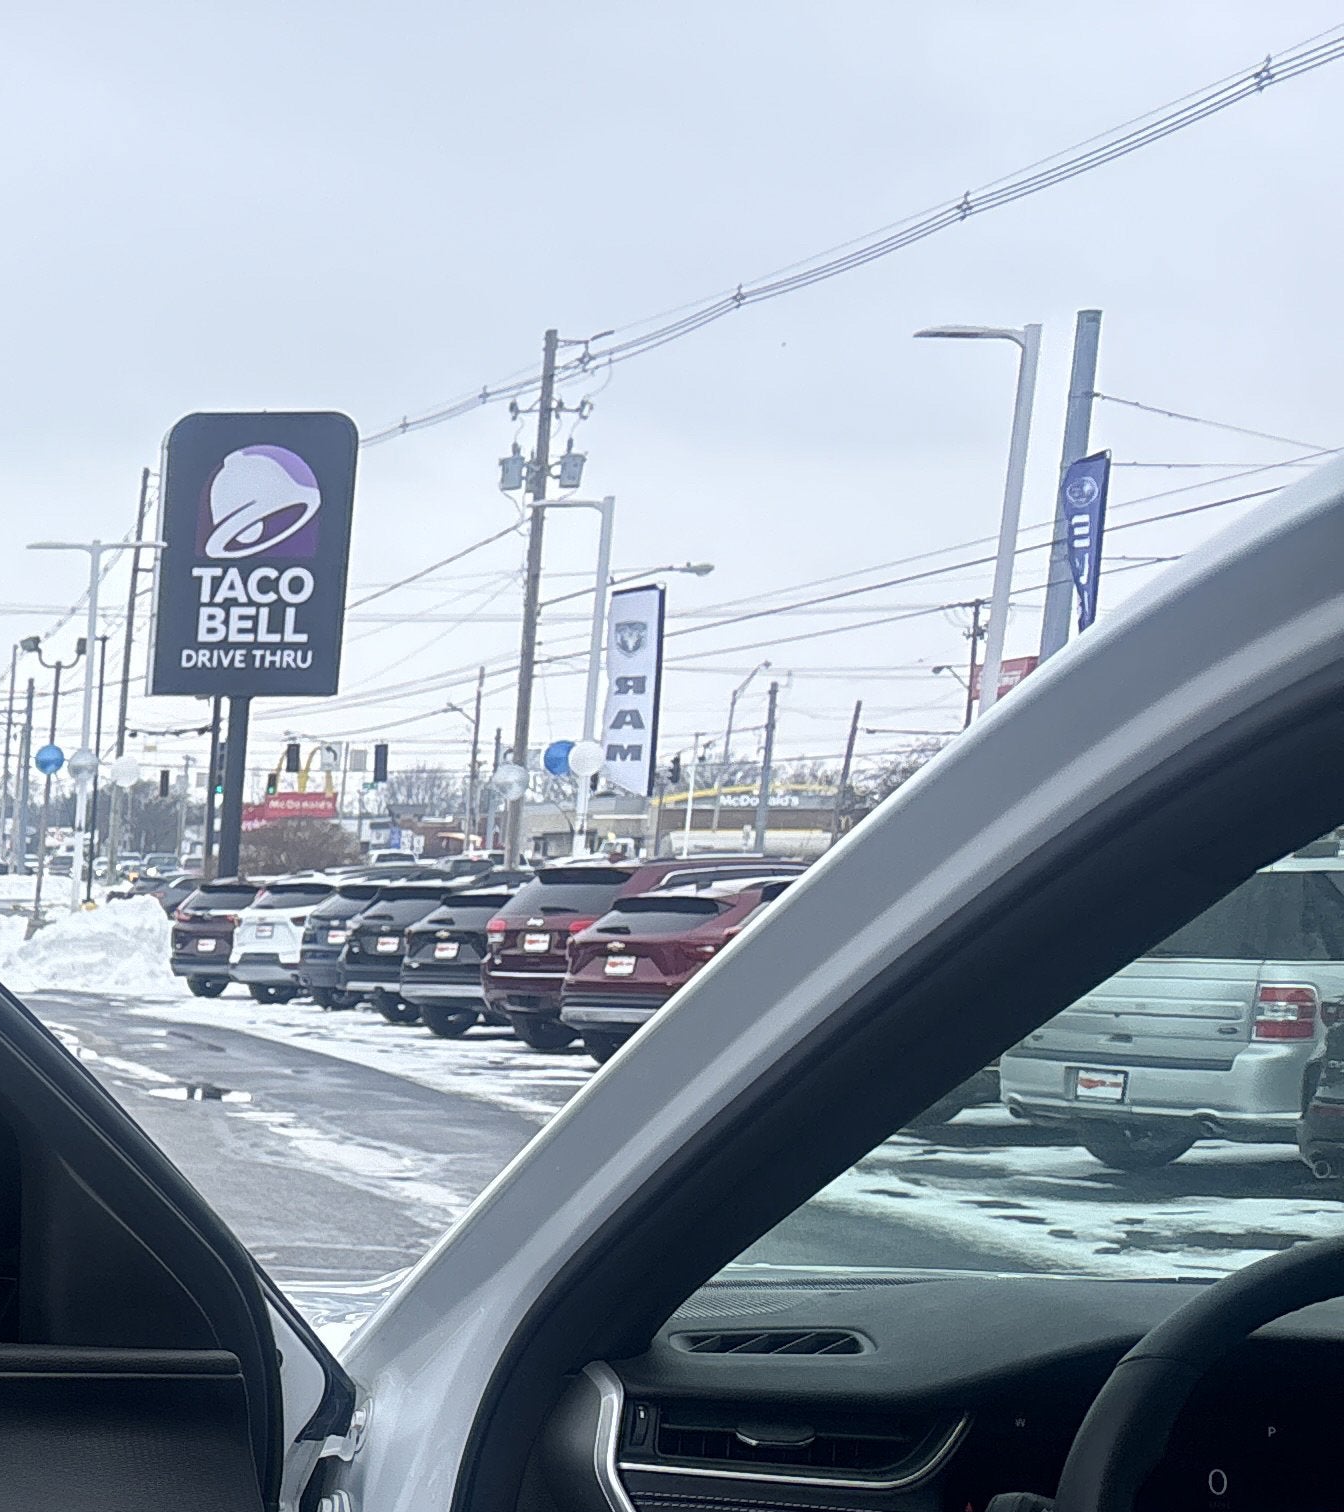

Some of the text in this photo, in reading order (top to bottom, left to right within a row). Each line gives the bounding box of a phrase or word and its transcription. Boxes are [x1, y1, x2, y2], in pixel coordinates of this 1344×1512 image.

[192, 567, 314, 603] TACO
[197, 606, 308, 643] BELL
[180, 649, 313, 669] DRIVE THRU
[1268, 1426, 1277, 1437] P
